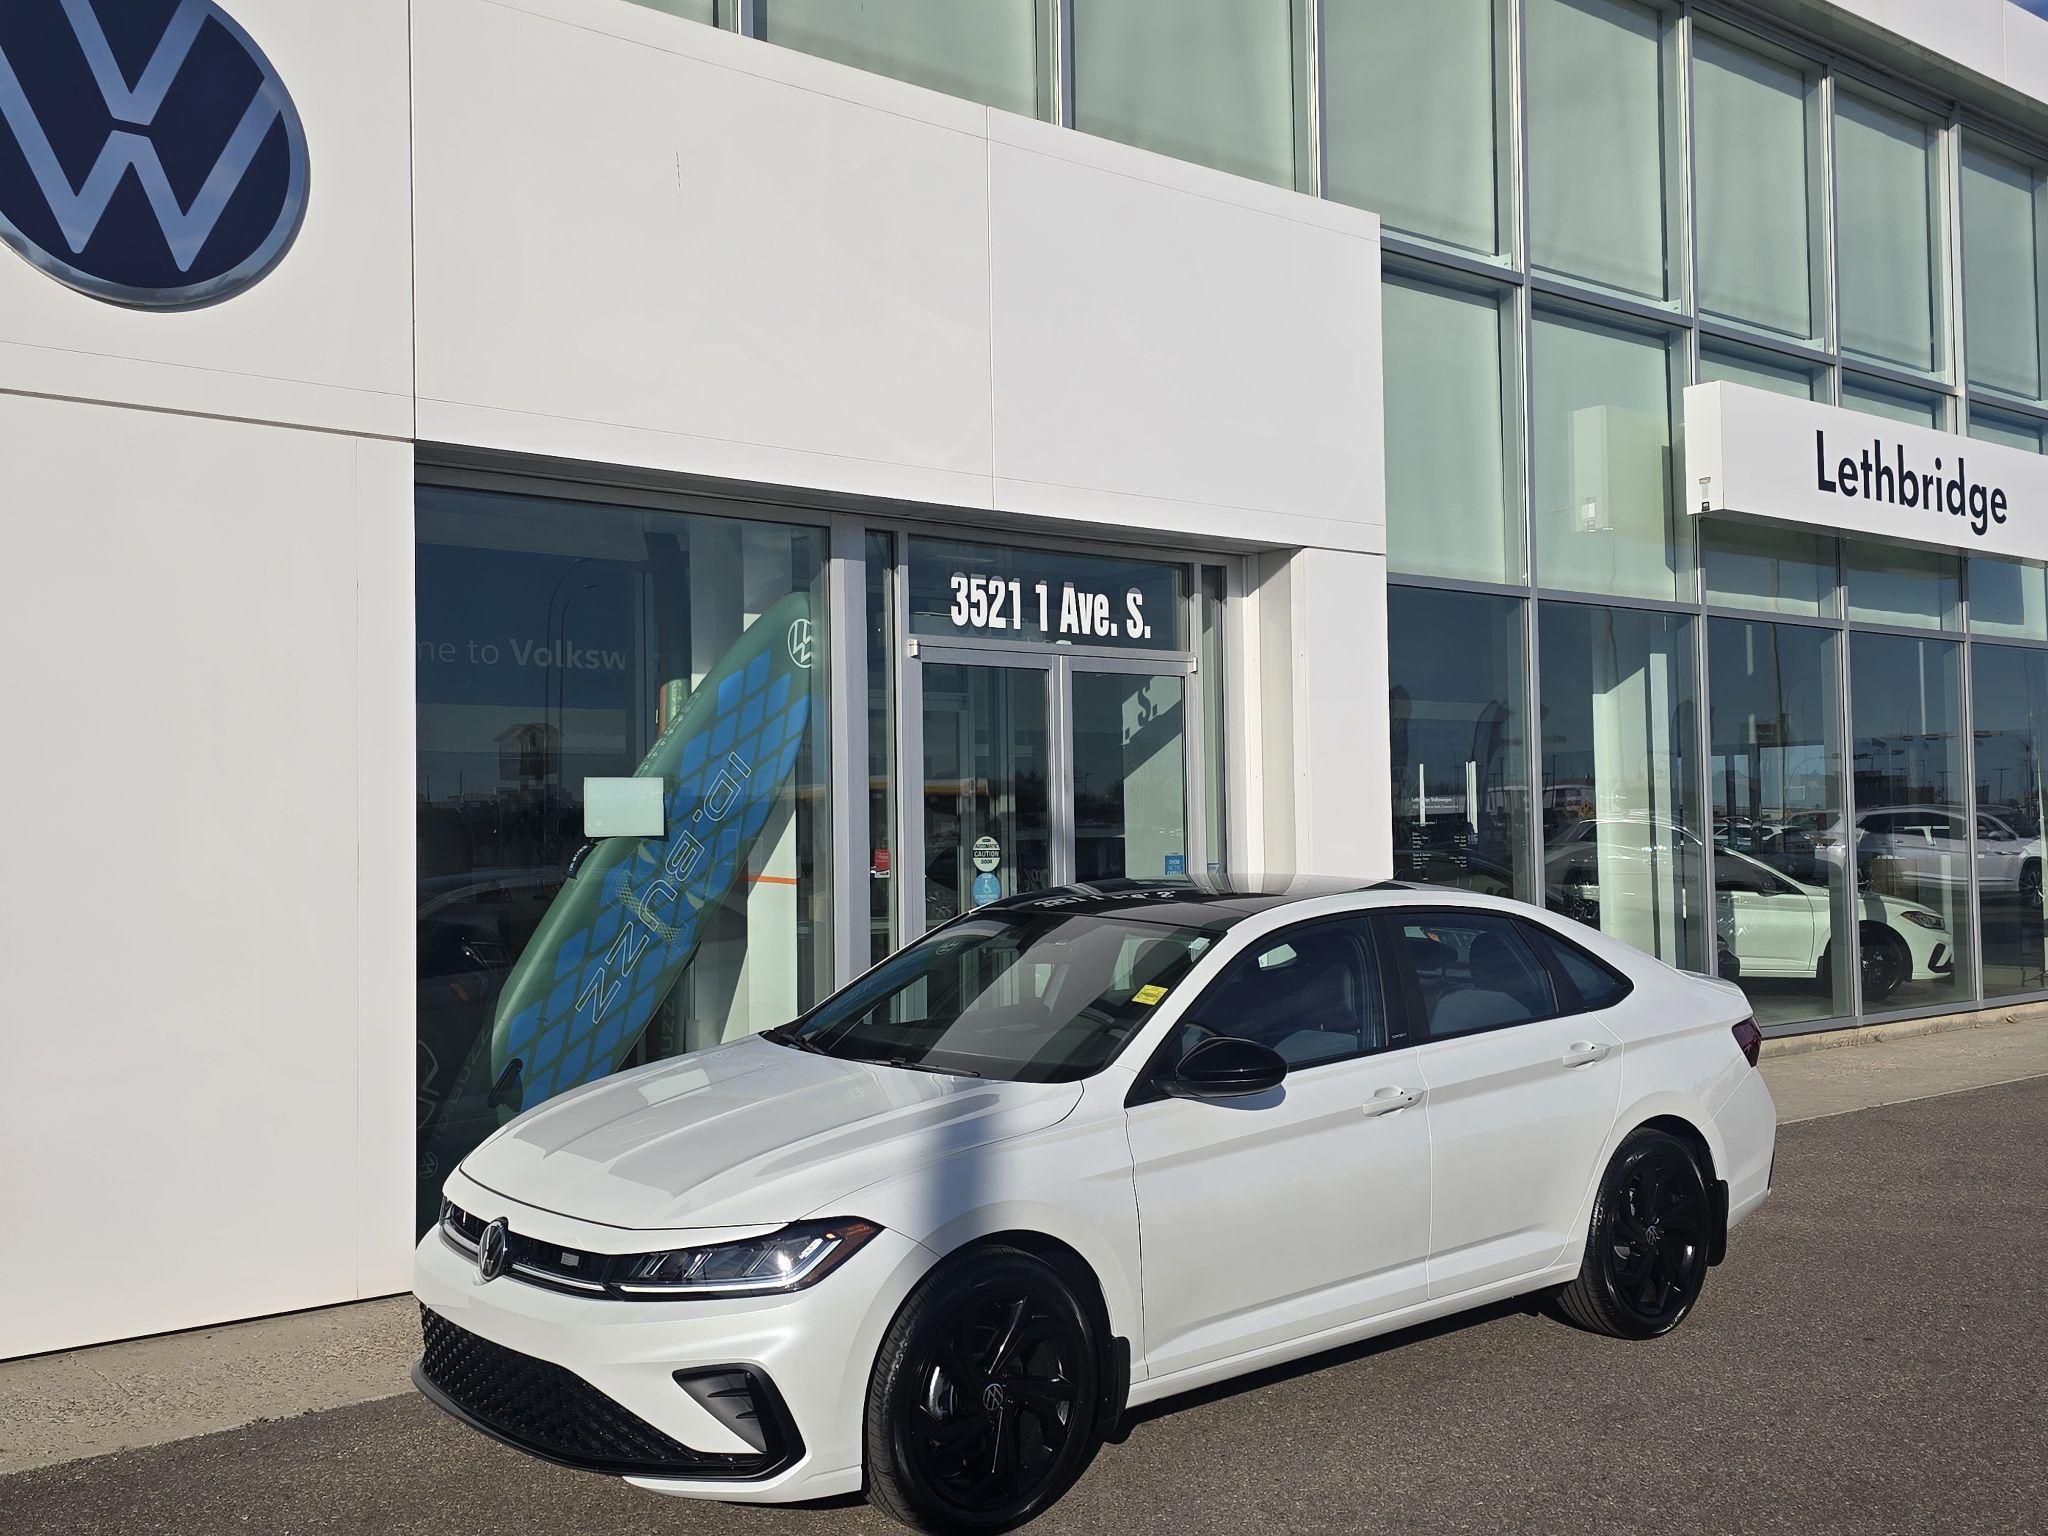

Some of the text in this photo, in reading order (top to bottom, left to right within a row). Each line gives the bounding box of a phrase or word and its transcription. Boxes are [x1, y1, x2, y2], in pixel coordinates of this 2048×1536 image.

[1815, 430, 2008, 536] Lethbridge
[950, 571, 1152, 639] 3521 1 Ave. S.
[466, 640, 499, 665] to
